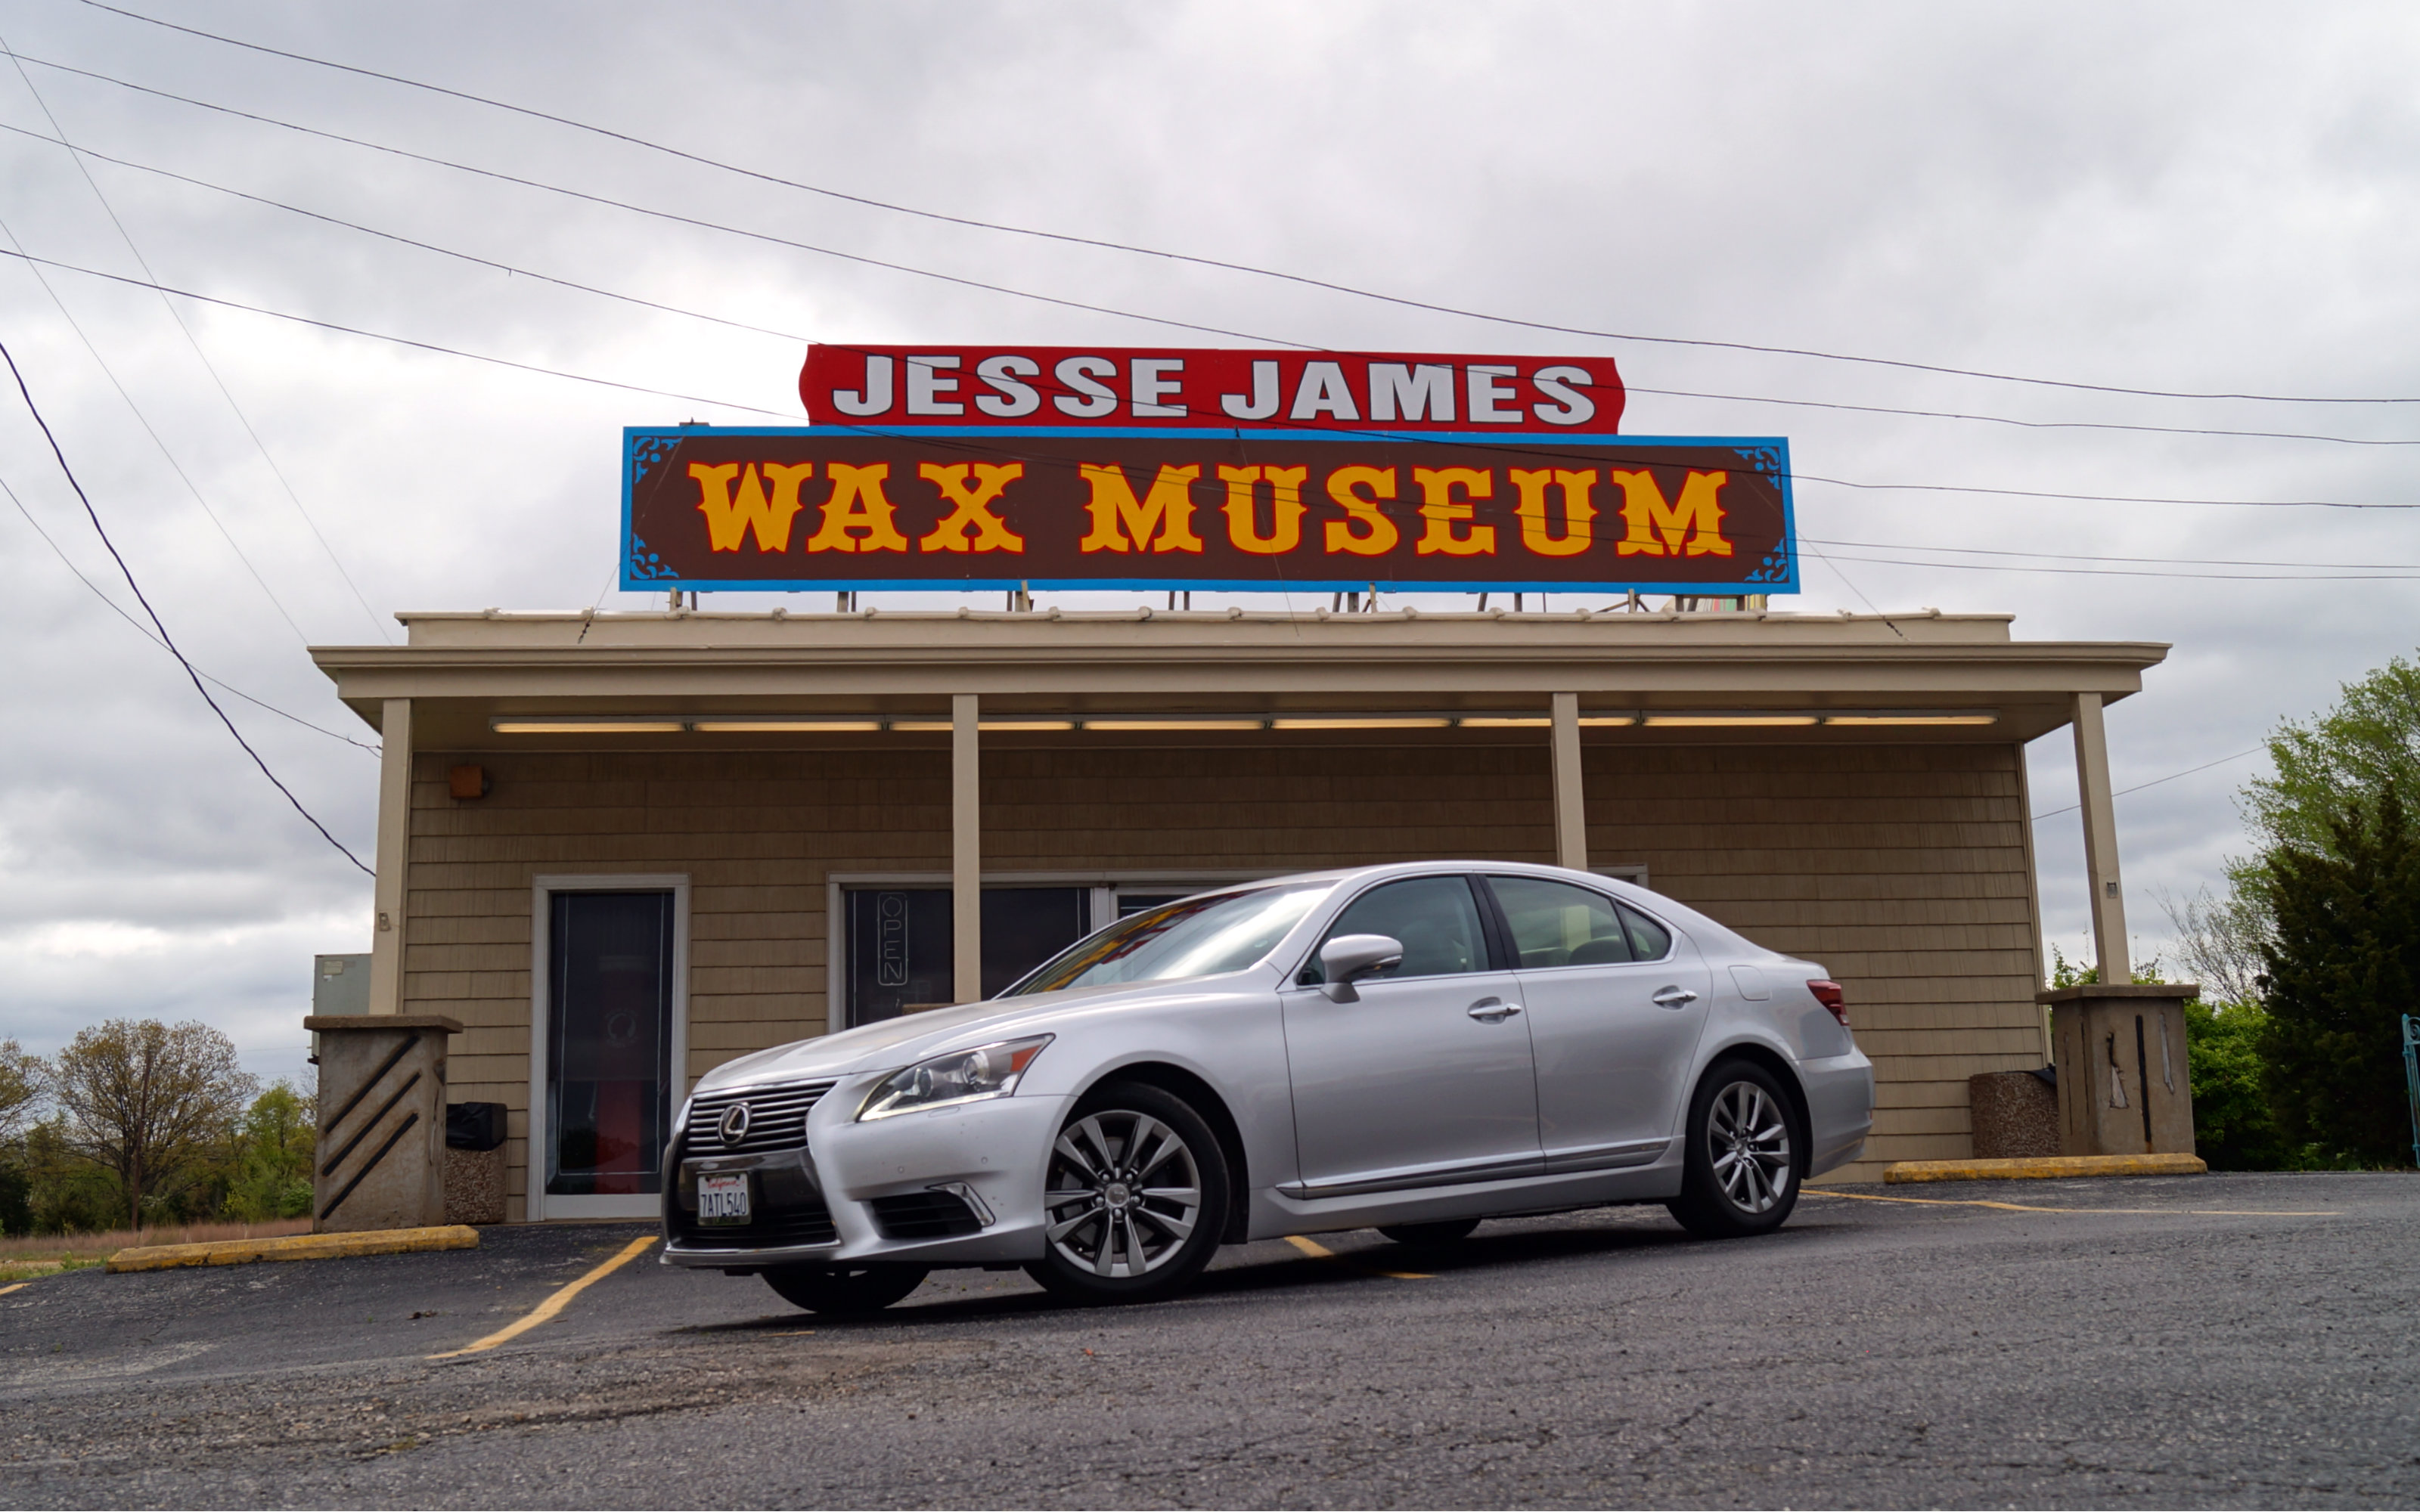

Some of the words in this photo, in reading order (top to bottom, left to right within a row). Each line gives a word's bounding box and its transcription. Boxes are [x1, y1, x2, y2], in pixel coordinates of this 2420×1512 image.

[832, 355, 1189, 418] JESSE
[1220, 360, 1596, 426] JAMES
[687, 461, 1025, 553] WAX
[1079, 463, 1734, 558] MUSEUM
[882, 896, 903, 980] OPEN
[700, 1191, 747, 1216] 7ATL540
